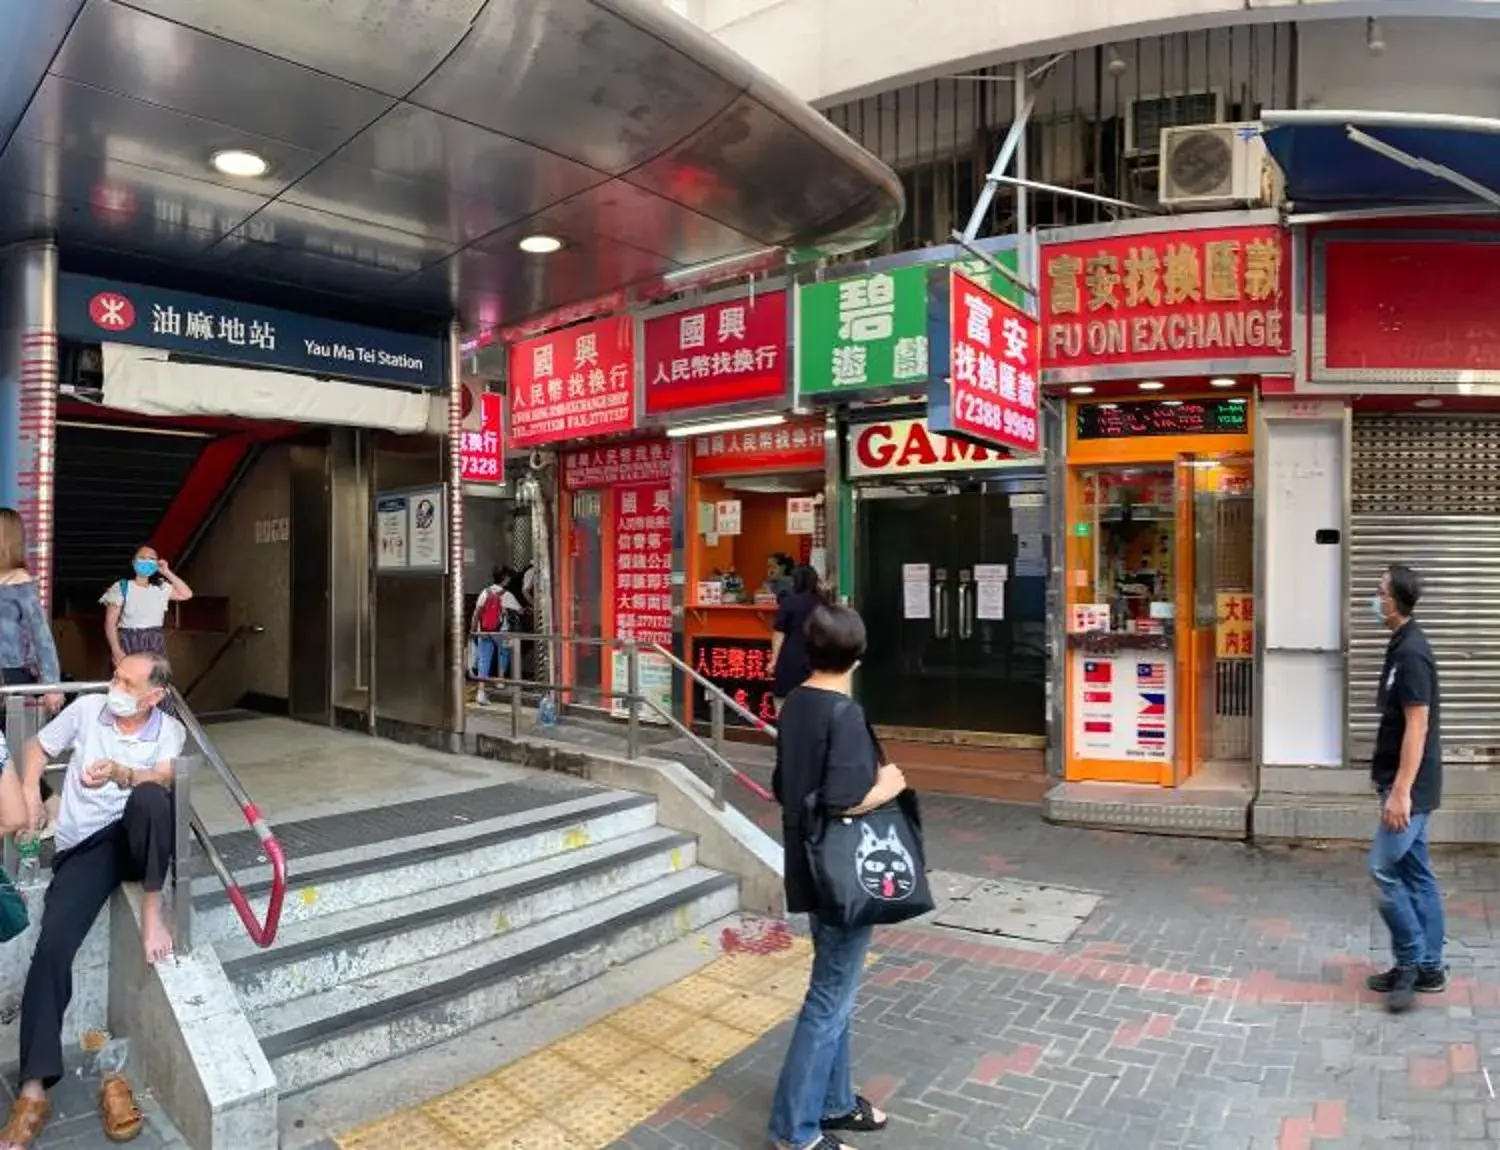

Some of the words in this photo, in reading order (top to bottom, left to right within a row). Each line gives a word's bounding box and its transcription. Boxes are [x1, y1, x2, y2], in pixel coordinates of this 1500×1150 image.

[1048, 238, 1282, 314] 富安找換匯款
[152, 303, 276, 350] 油麻地站
[838, 274, 895, 342] 碧
[964, 292, 1028, 364] 富安
[304, 339, 331, 357] Yau
[333, 345, 355, 361] Ma
[358, 346, 376, 363] Tei
[378, 351, 424, 371] Station
[1050, 322, 1082, 358] FU
[1087, 319, 1126, 354] ON
[1132, 309, 1282, 351] EXCHANGE
[512, 363, 629, 411] 人民幣找換行
[652, 345, 778, 385] 人民幣找換行
[955, 341, 1036, 410] 找換匯款
